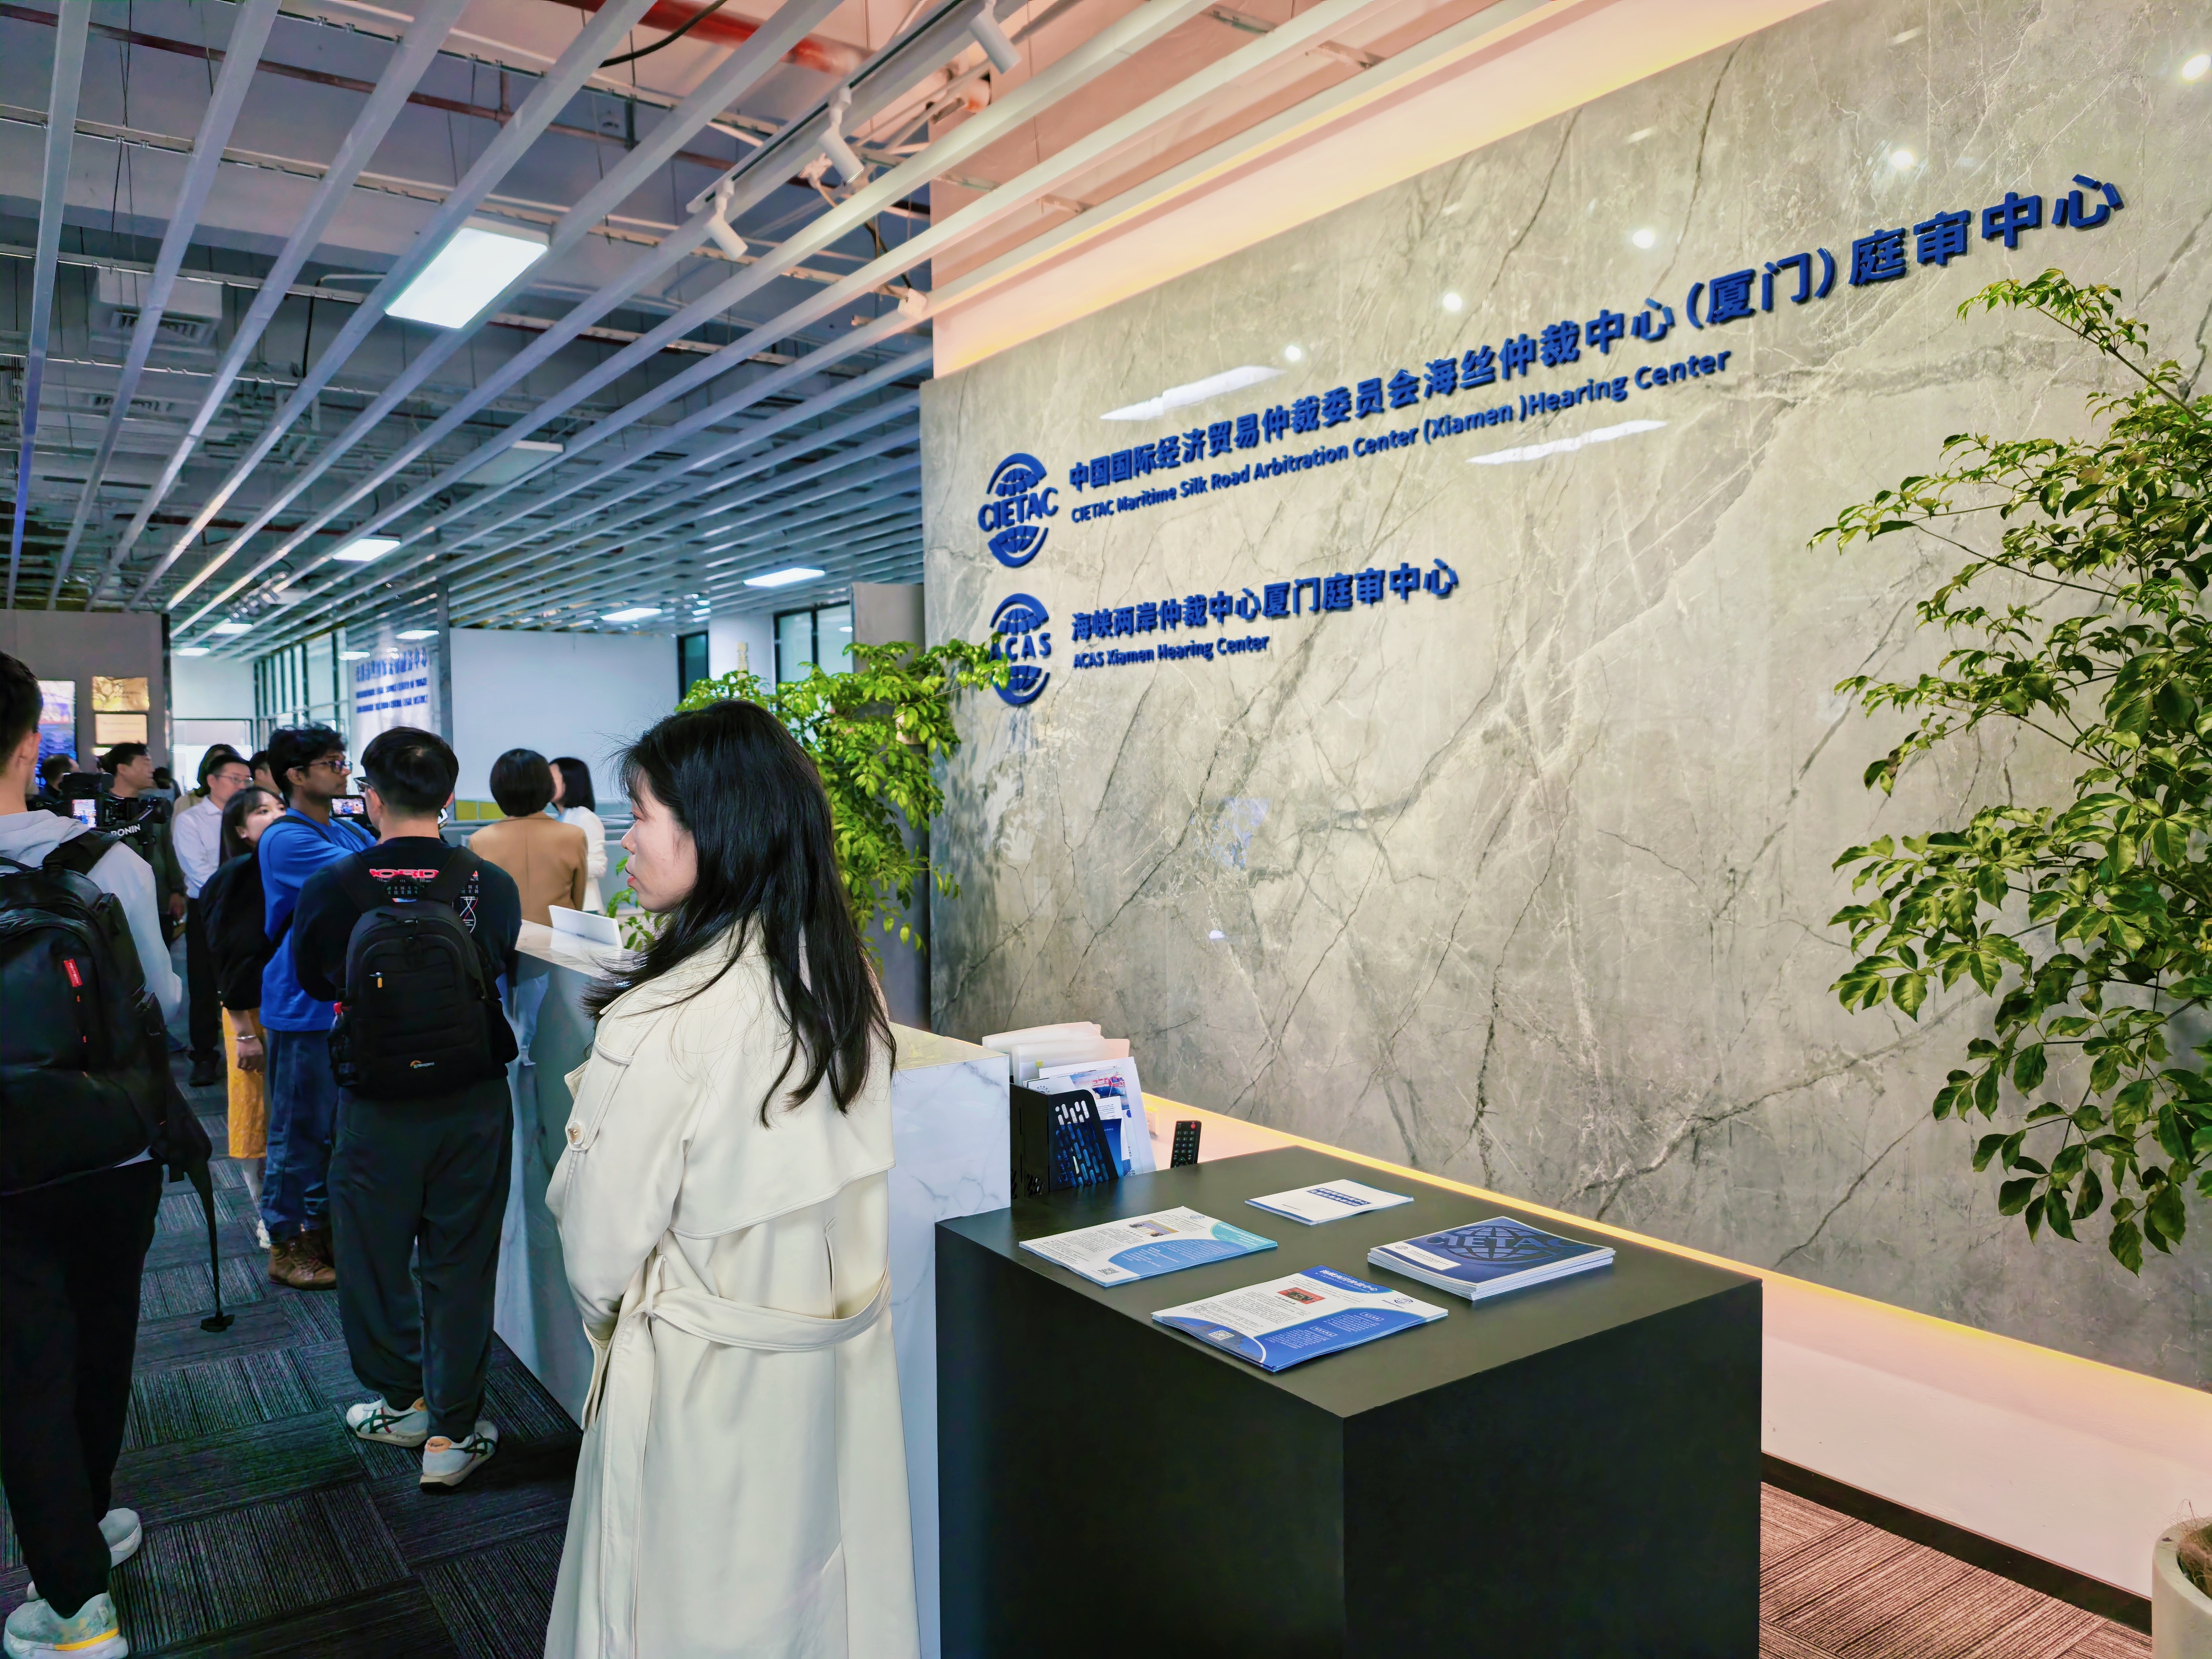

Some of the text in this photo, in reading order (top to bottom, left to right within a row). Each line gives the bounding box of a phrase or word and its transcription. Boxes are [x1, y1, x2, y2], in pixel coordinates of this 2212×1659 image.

[1071, 500, 1114, 523] CIETAC
[1117, 487, 1177, 512] Maritime
[1180, 476, 1208, 498] Silk
[1211, 464, 1250, 490] Road
[1253, 445, 1348, 480] Arbitration
[1353, 428, 1419, 457] Center
[1635, 351, 1731, 389] Center
[978, 487, 1058, 532] CIETAC
[1071, 558, 1459, 641] 海峡两岸仲裁中心厦门庭审中心
[989, 632, 1051, 662] ACAS
[1073, 636, 1270, 668] ACAS Xiamen Hearing Center
[369, 869, 439, 878] ORD
